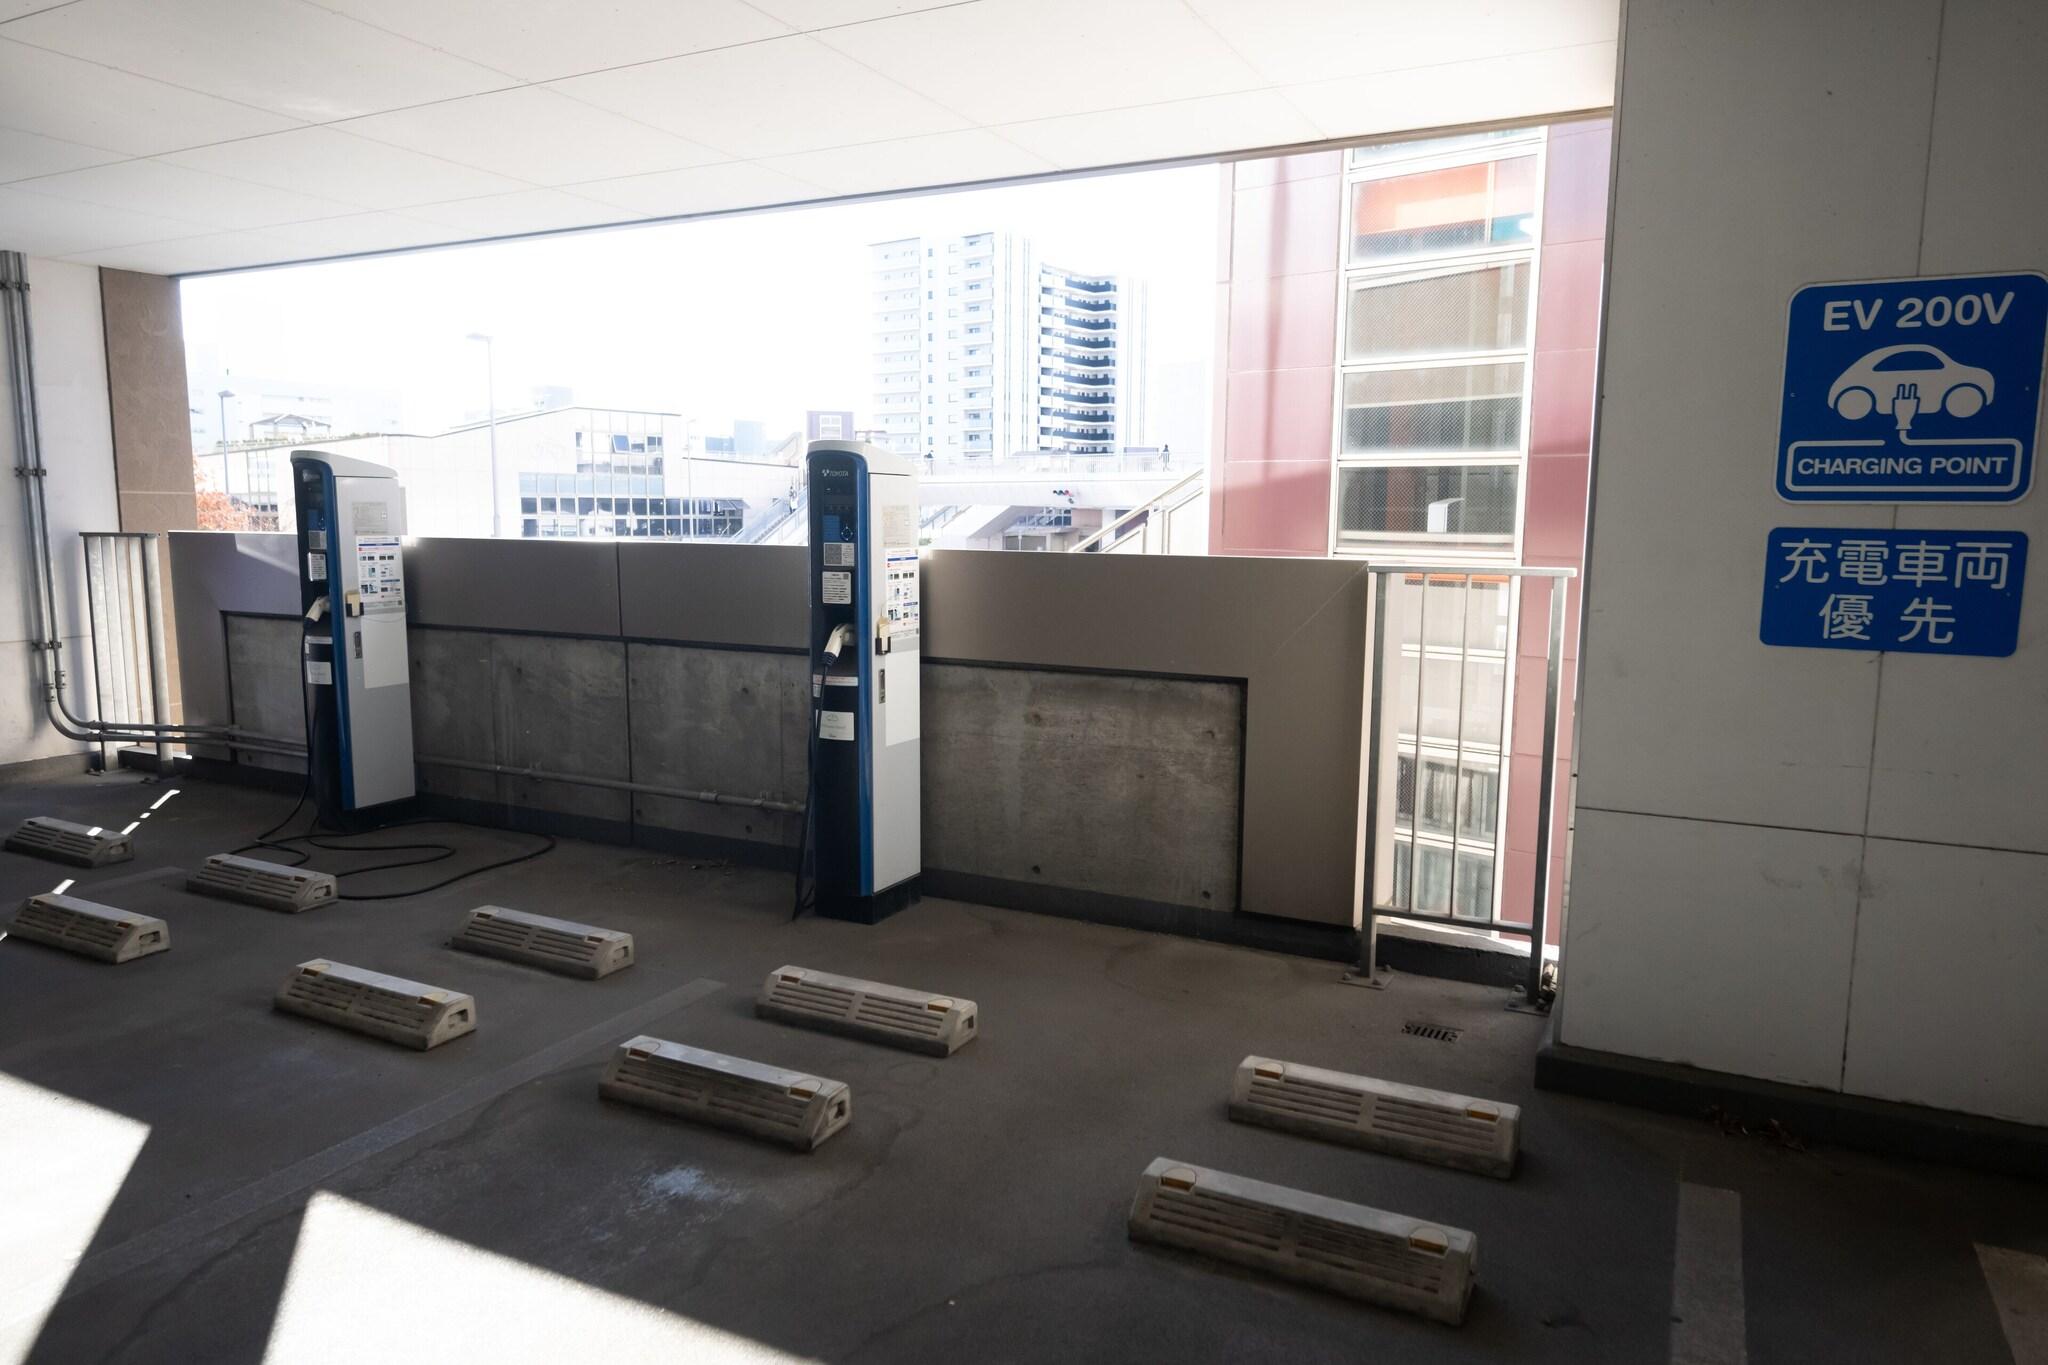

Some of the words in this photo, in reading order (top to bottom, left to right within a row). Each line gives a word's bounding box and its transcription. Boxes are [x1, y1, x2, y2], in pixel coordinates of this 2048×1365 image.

[1823, 298, 1883, 331] EV
[1896, 291, 2015, 328] 200V
[1797, 457, 1923, 475] CHARGING
[1930, 456, 2008, 475] POINT
[1778, 537, 2014, 590] 充電車両
